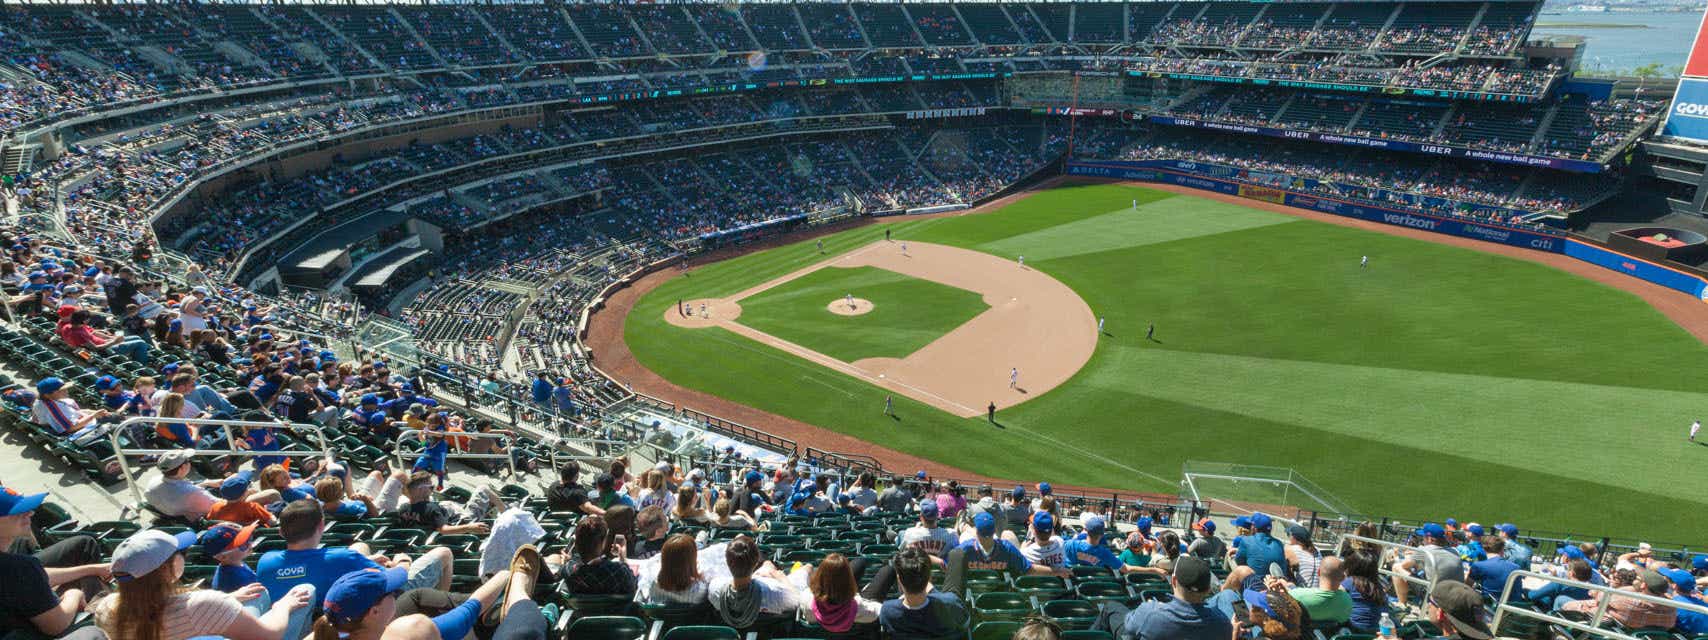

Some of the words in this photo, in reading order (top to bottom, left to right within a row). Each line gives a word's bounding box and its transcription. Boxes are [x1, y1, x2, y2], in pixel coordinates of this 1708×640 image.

[1284, 130, 1310, 139] UBER
[1421, 144, 1452, 155] UBER
[1472, 151, 1494, 159] whole
[1384, 213, 1435, 230] verizon
[1530, 238, 1552, 250] citi
[276, 566, 304, 576] GOYA
